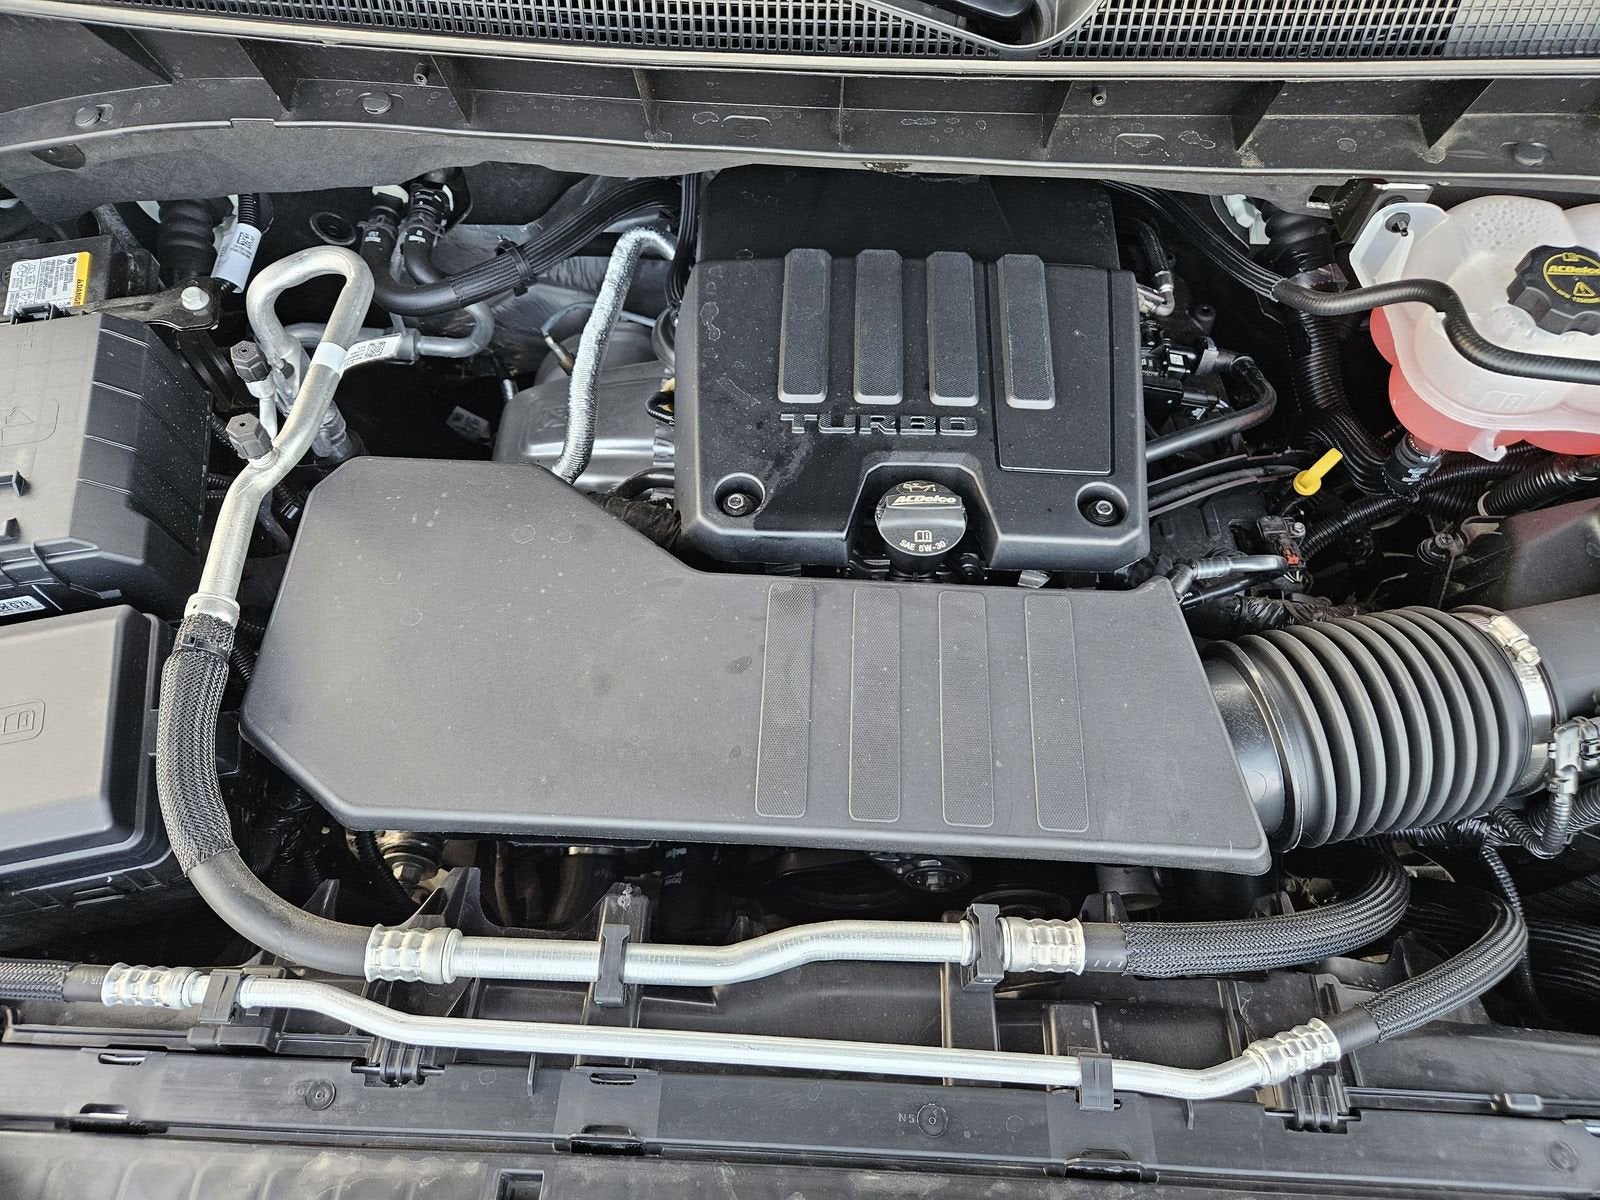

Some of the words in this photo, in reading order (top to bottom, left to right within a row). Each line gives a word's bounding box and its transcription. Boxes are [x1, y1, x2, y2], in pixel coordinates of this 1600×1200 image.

[780, 414, 978, 436] TURBO
[891, 495, 957, 505] ACDelco
[900, 540, 915, 551] SAE
[919, 540, 946, 552] 5W-30
